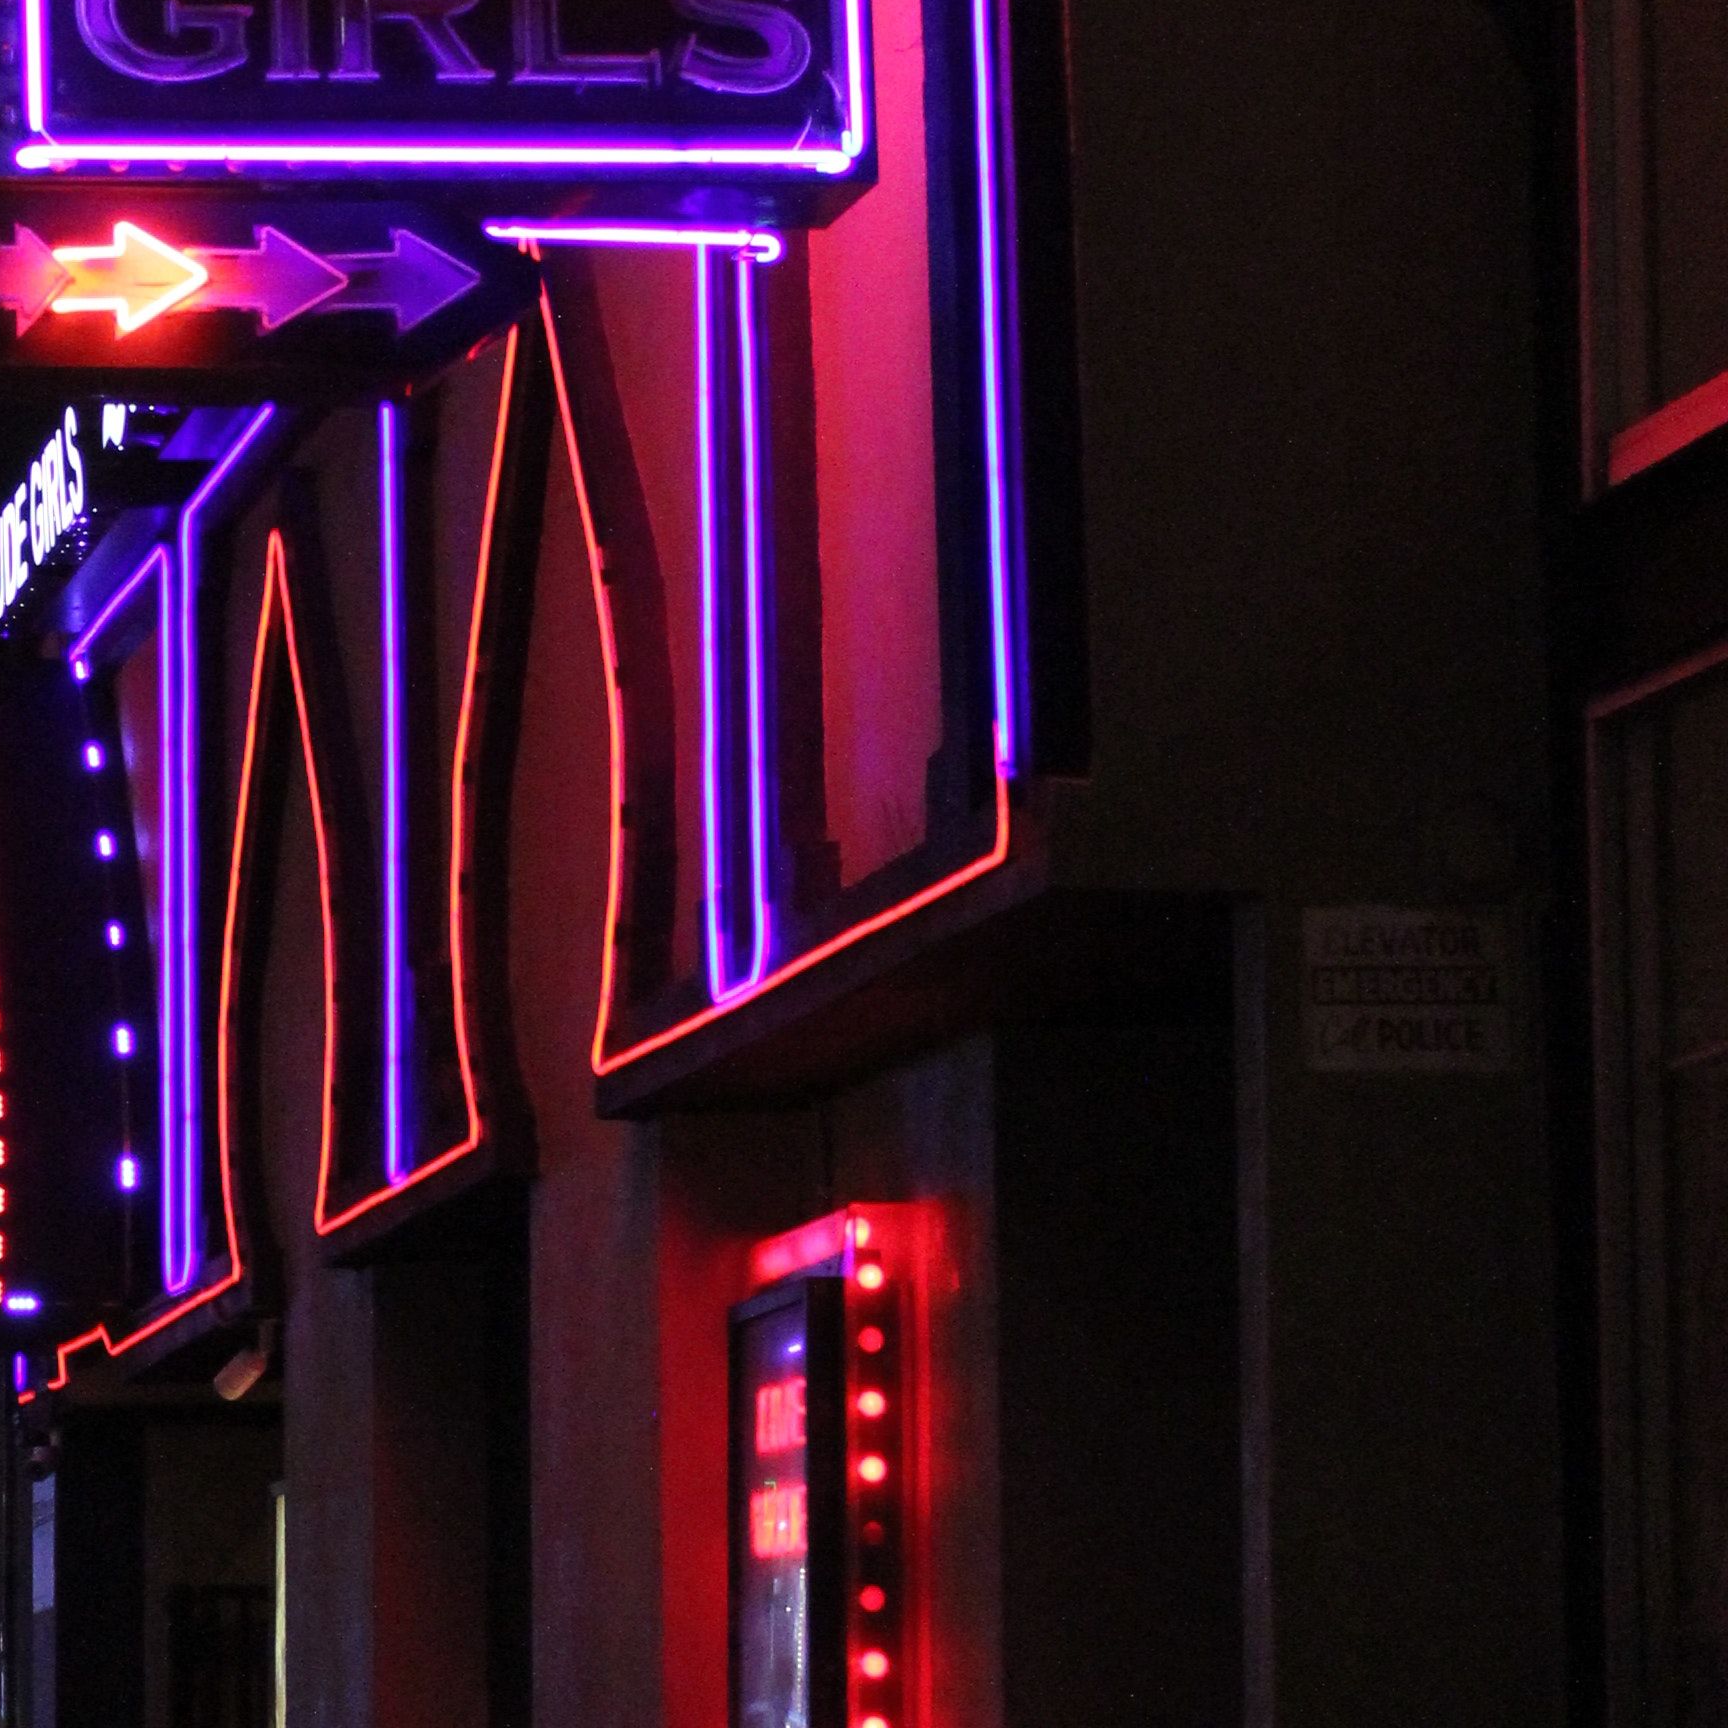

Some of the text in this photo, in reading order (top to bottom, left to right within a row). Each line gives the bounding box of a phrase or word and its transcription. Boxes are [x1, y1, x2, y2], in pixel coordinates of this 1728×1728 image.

[30, 405, 84, 566] GIRLS
[1323, 924, 1480, 957] ELEVATOR
[1377, 1017, 1485, 1053] POLICE
